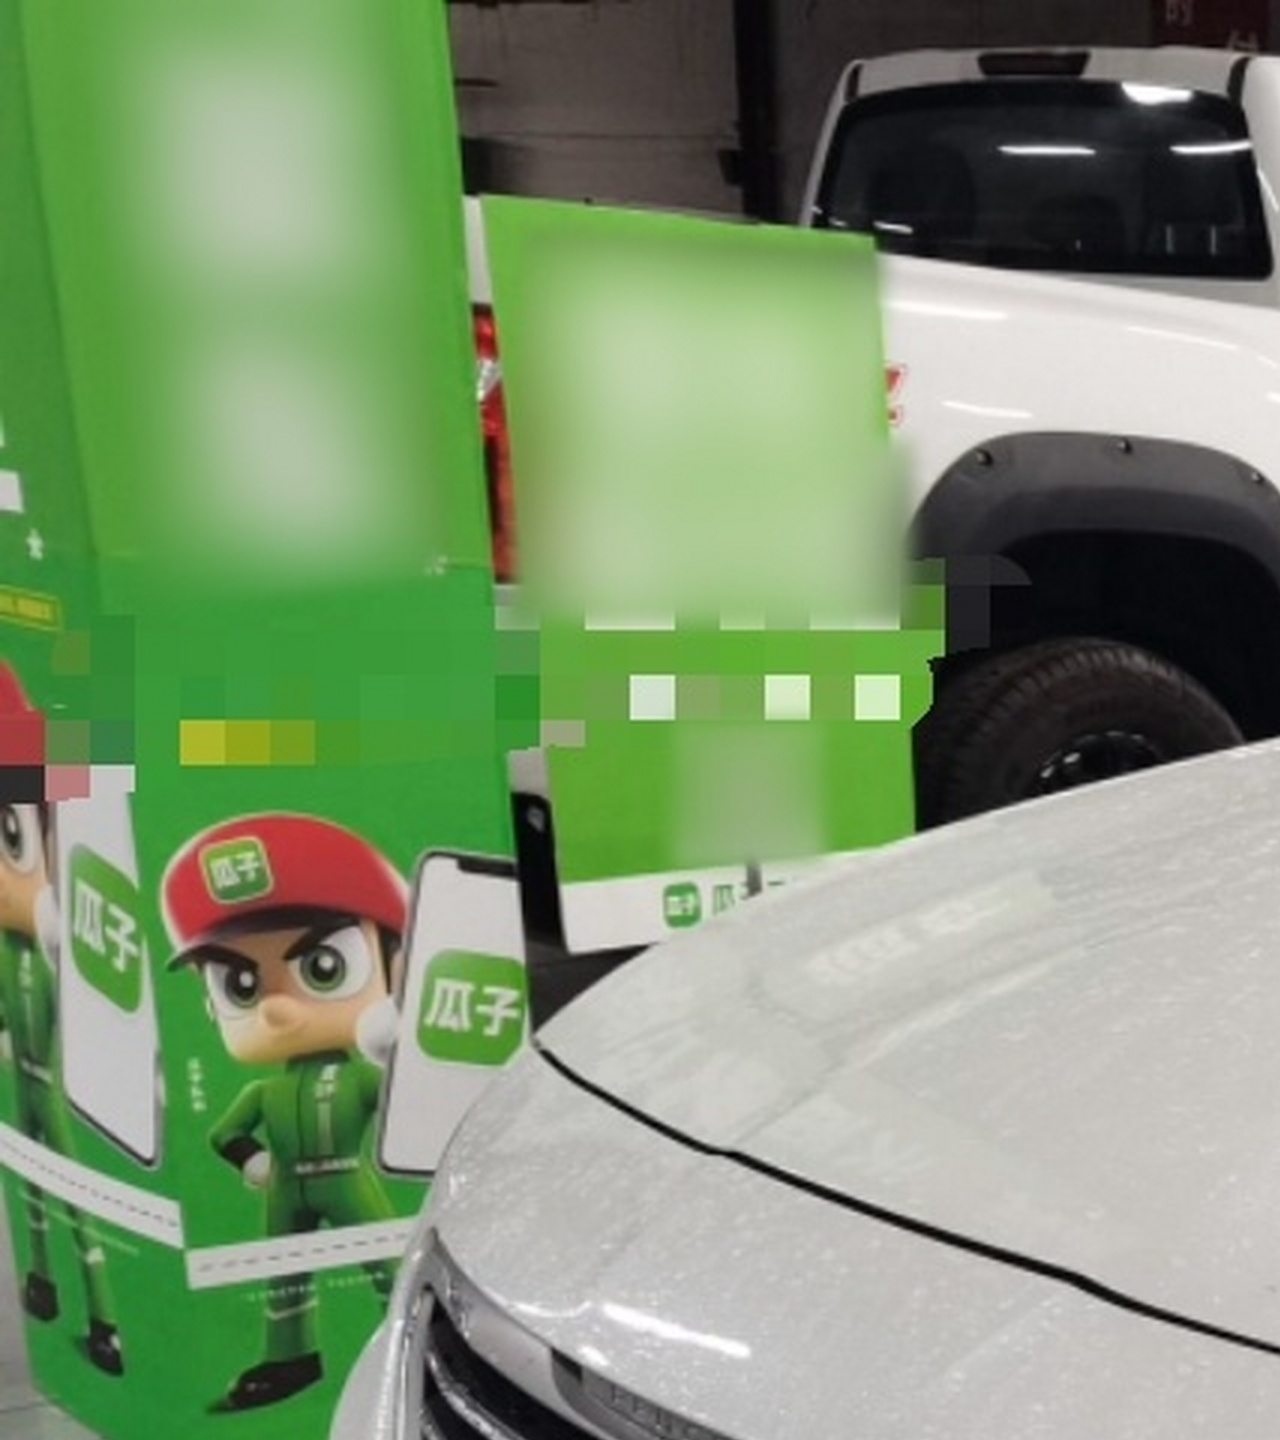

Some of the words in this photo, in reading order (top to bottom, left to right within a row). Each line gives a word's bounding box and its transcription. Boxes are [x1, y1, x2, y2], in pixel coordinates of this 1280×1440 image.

[209, 851, 259, 889] 瓜子
[73, 876, 139, 973] 瓜子
[424, 977, 520, 1036] 瓜子
